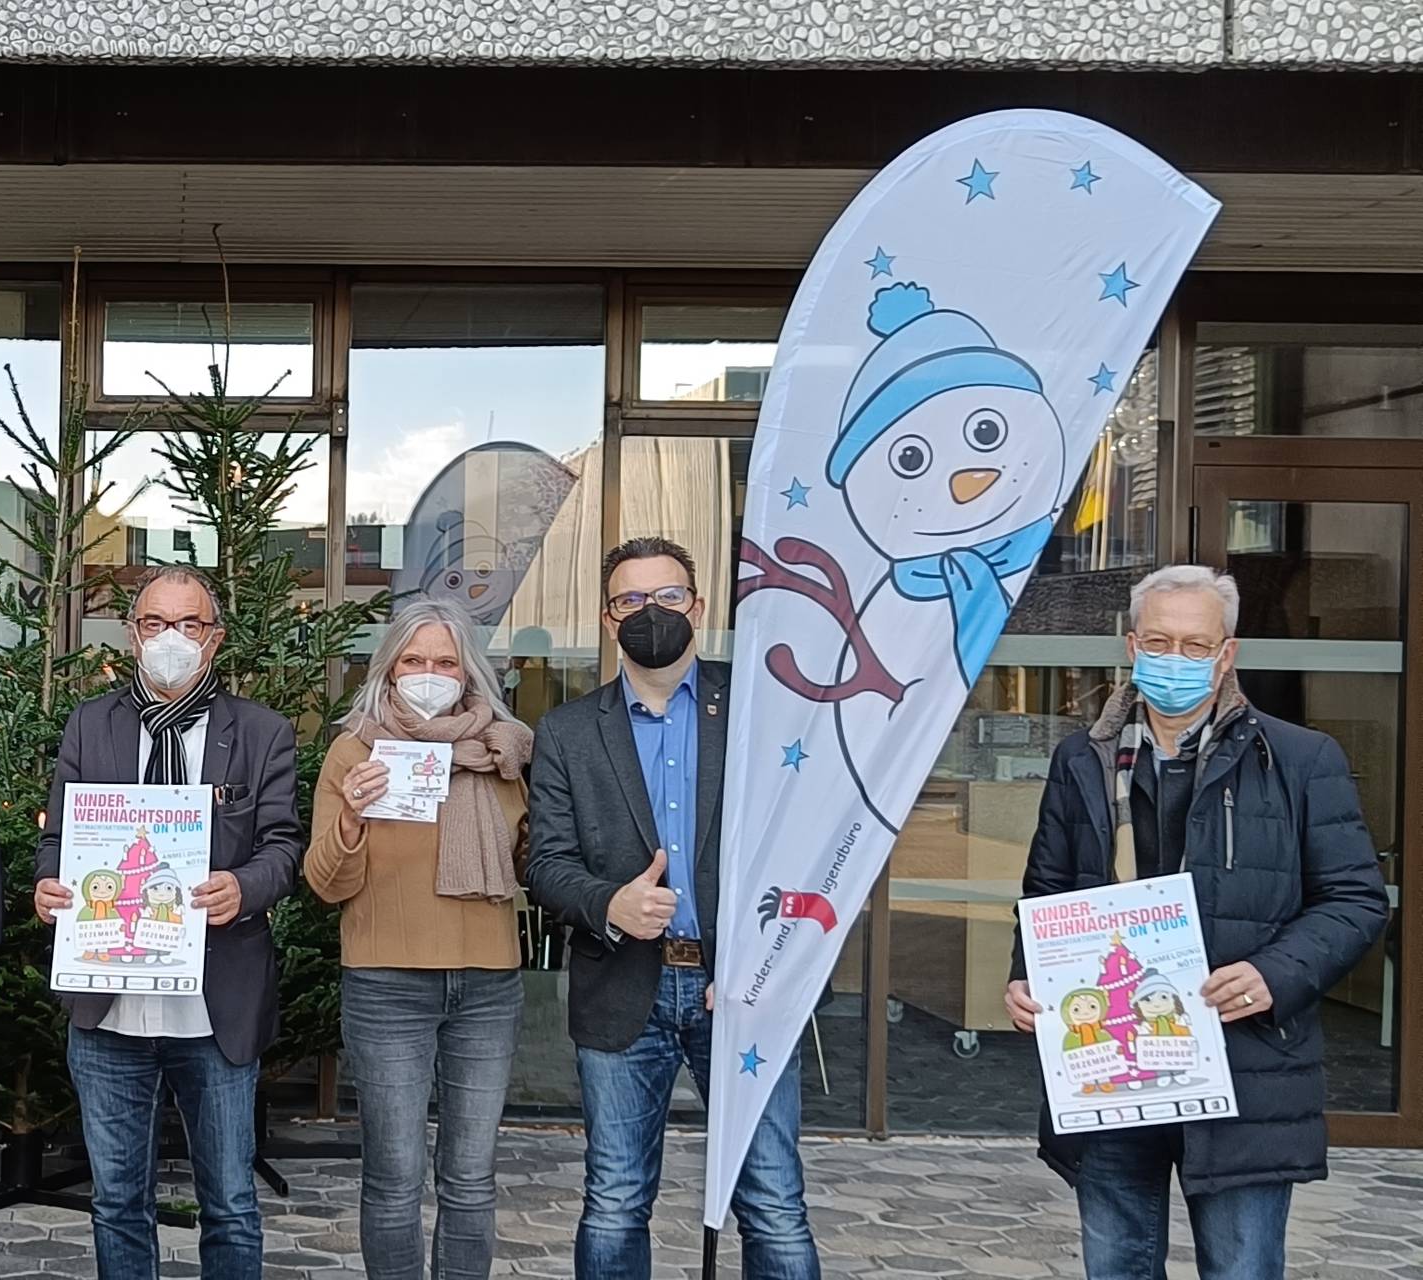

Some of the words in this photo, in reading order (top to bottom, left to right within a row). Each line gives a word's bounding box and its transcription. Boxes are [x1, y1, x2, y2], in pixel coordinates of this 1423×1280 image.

[74, 793, 131, 807] KINDER-
[74, 808, 202, 823] WEIHNACHTSDORF
[153, 823, 168, 834] ON
[1031, 901, 1097, 924] KINDER-
[1033, 903, 1184, 941] WEIHNACHTSDORF
[1128, 923, 1148, 938] ON
[1153, 915, 1189, 934] TOUR
[741, 954, 775, 1008] Kinder-
[772, 923, 791, 953] und
[1146, 946, 1202, 966] ANMELDUNG
[1069, 1053, 1119, 1071] DEZEMBER
[1143, 1050, 1193, 1058] DEZEMBER
